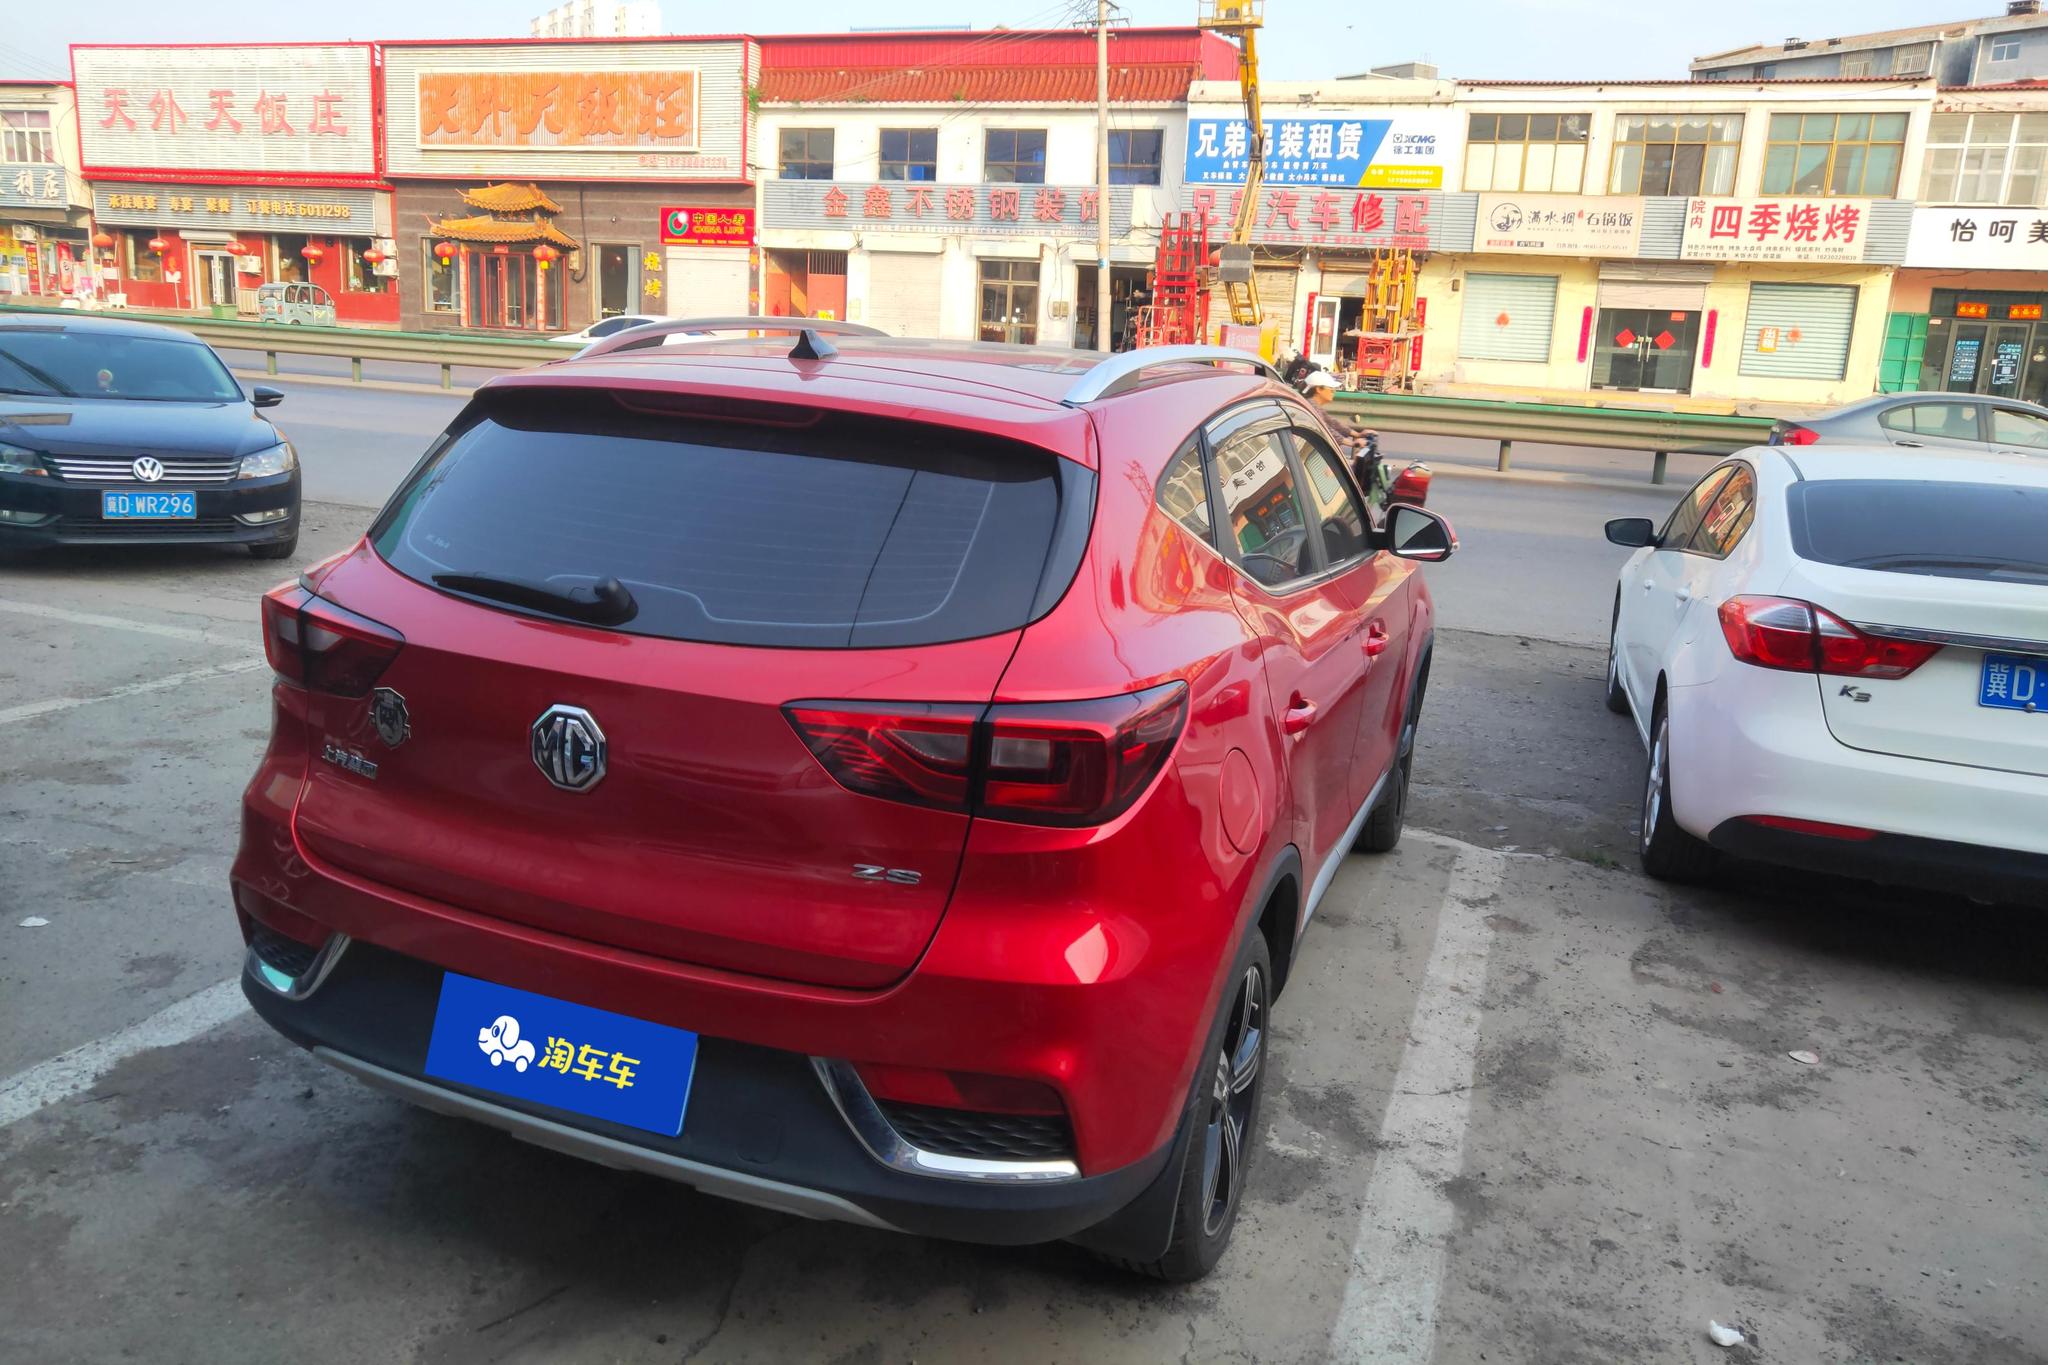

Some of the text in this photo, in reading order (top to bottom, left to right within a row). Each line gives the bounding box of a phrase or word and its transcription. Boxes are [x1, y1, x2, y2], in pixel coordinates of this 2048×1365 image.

[100, 88, 349, 137] 天外天饭庄
[1393, 145, 1435, 155] 徐工集团
[1404, 135, 1436, 144] XCMG
[0, 169, 60, 199] 利店
[692, 213, 745, 225] 中国人寿
[1587, 212, 1633, 227] 石锅饭
[1690, 201, 1706, 229] 院内
[1710, 203, 1861, 243] 四季烧烤
[692, 226, 745, 235] CHINA LIFE
[1950, 218, 2048, 244] 怡呵美
[644, 251, 663, 298] 烧烤
[1839, 685, 1873, 703] K3
[851, 863, 922, 885] ZS
